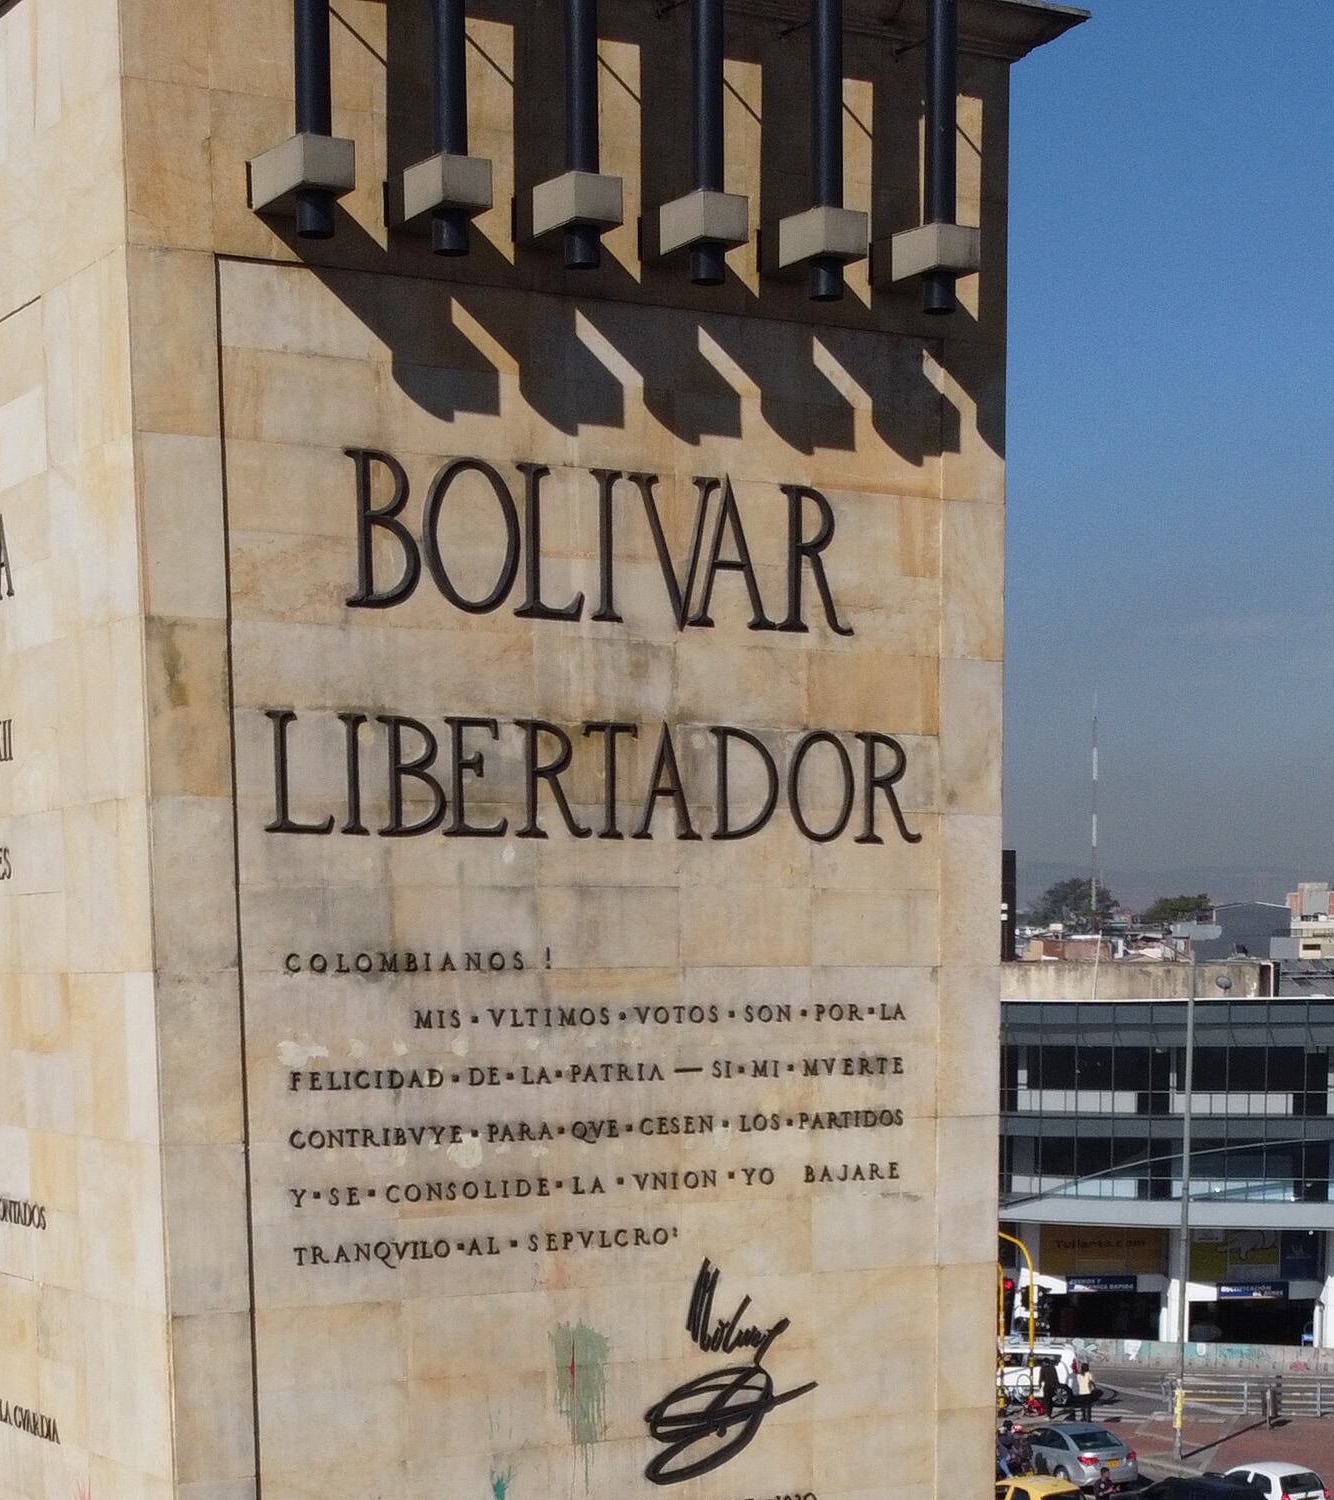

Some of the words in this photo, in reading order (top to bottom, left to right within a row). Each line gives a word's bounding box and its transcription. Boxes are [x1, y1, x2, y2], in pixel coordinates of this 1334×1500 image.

[343, 447, 854, 636] BOLIVAR
[264, 709, 923, 844] LIBERTADOR
[285, 951, 526, 974] COLOMBIANOS
[414, 1009, 461, 1030] MIS
[489, 1006, 611, 1029] VLTIMOS
[634, 1004, 719, 1026] VOTOS
[743, 1003, 791, 1025] SON
[815, 1002, 865, 1022] POR
[879, 1002, 906, 1021] LA
[290, 1067, 444, 1092] FELICIDAD
[468, 1065, 501, 1088] DE
[521, 1064, 551, 1085] LA
[570, 1062, 665, 1084] PATRIA
[711, 1058, 735, 1079] SI
[751, 1058, 780, 1077] MI
[803, 1056, 905, 1077] MVERTE
[289, 1123, 463, 1151] CONTRIBVYE
[487, 1121, 554, 1145] PARA
[639, 1115, 715, 1136] CESEN
[739, 1112, 781, 1133] LOS
[798, 1109, 905, 1131] PARTIDOS
[290, 1189, 306, 1209] Y
[328, 1186, 360, 1206] SE
[385, 1176, 548, 1204] CONSOLIDE
[572, 1174, 606, 1196] LA
[633, 1169, 716, 1191] VNION
[741, 1168, 775, 1188] YO
[803, 1162, 901, 1183] BAJARE
[293, 1239, 451, 1270] TRANQVILO
[466, 1236, 499, 1257] AL
